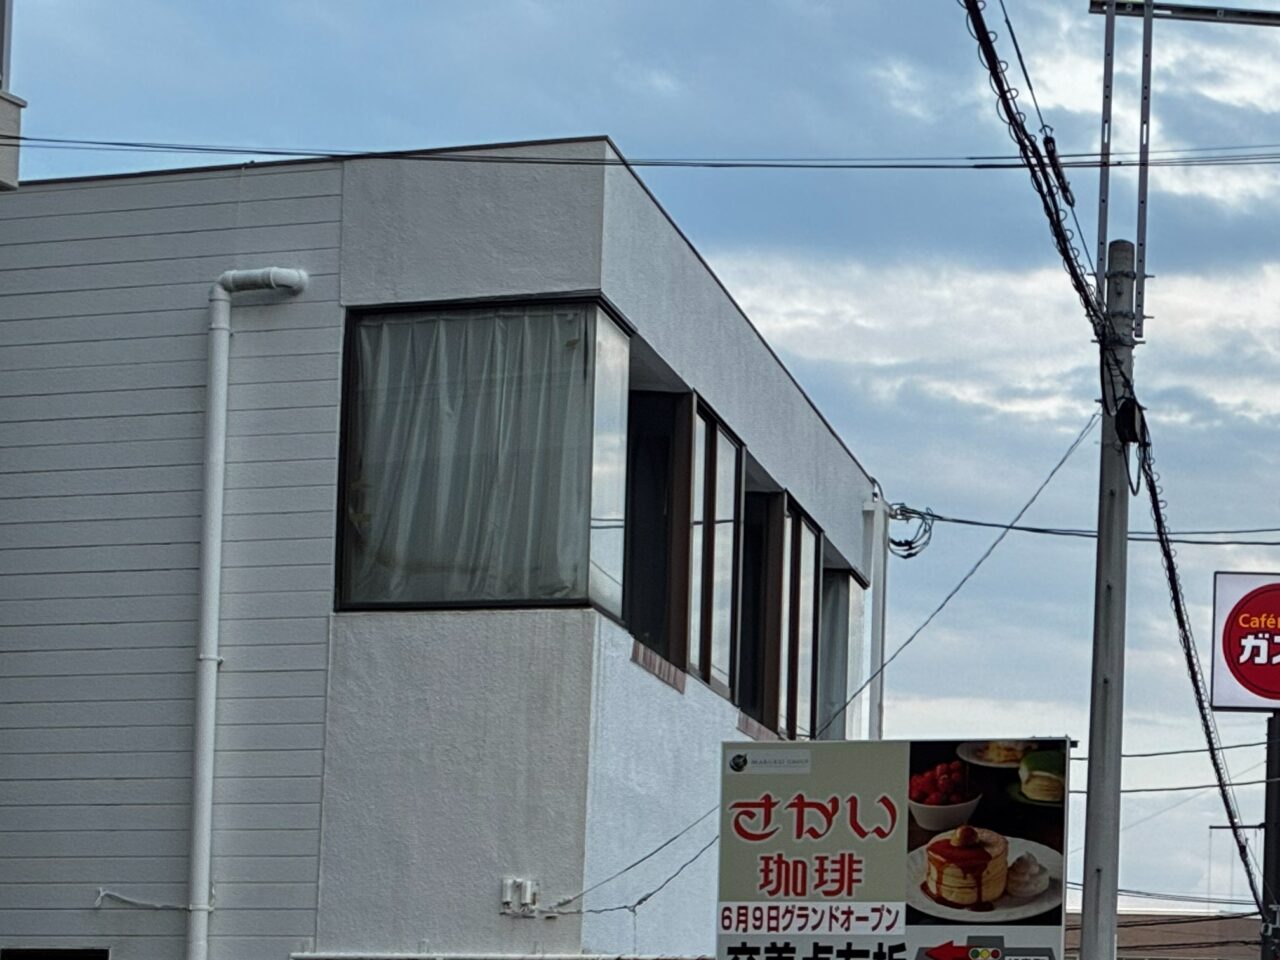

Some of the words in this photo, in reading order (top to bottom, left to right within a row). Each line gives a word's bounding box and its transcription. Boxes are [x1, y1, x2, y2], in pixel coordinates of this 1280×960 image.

[728, 793, 898, 841] さかい
[758, 852, 863, 898] 珈琲
[720, 904, 900, 933] 6月9日グランドオープン
